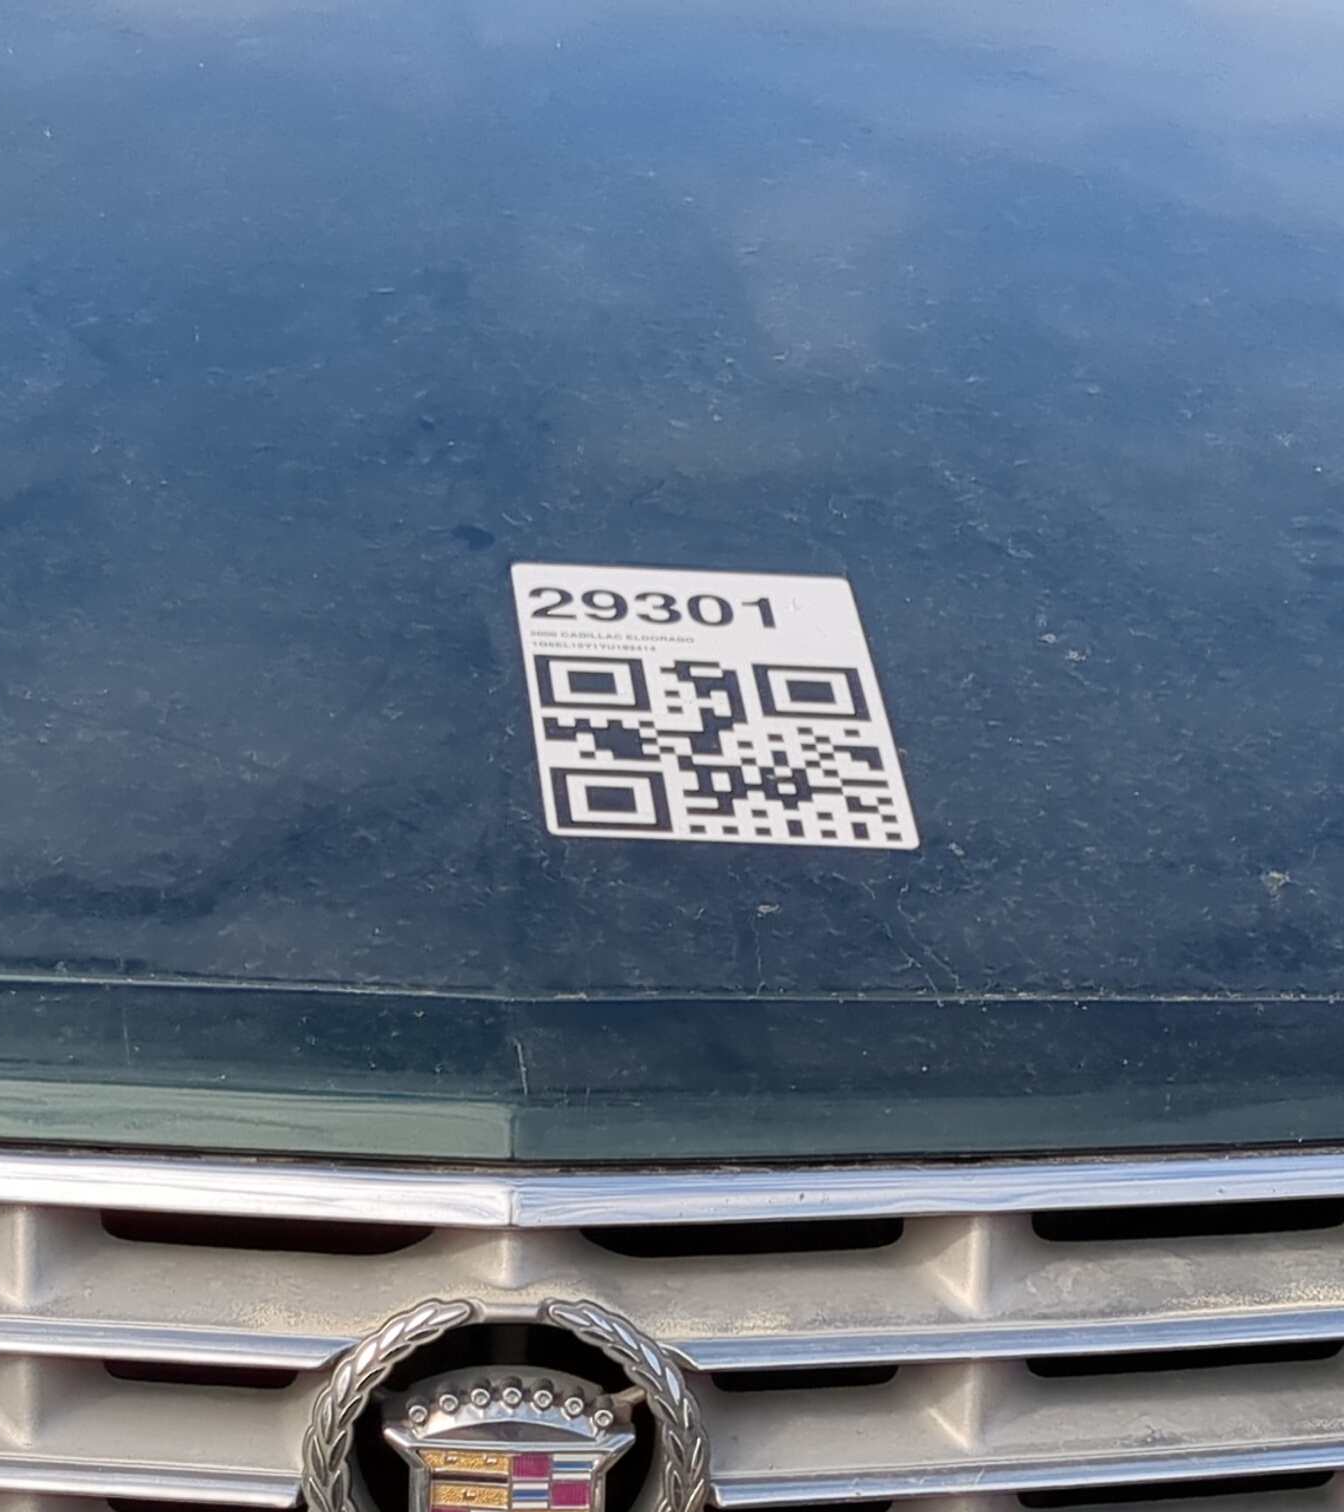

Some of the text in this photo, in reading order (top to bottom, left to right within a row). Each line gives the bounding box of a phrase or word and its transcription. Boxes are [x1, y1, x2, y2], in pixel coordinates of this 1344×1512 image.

[528, 586, 777, 629] 29301
[560, 632, 622, 641] CADILLAC
[625, 634, 695, 644] ELDORADO
